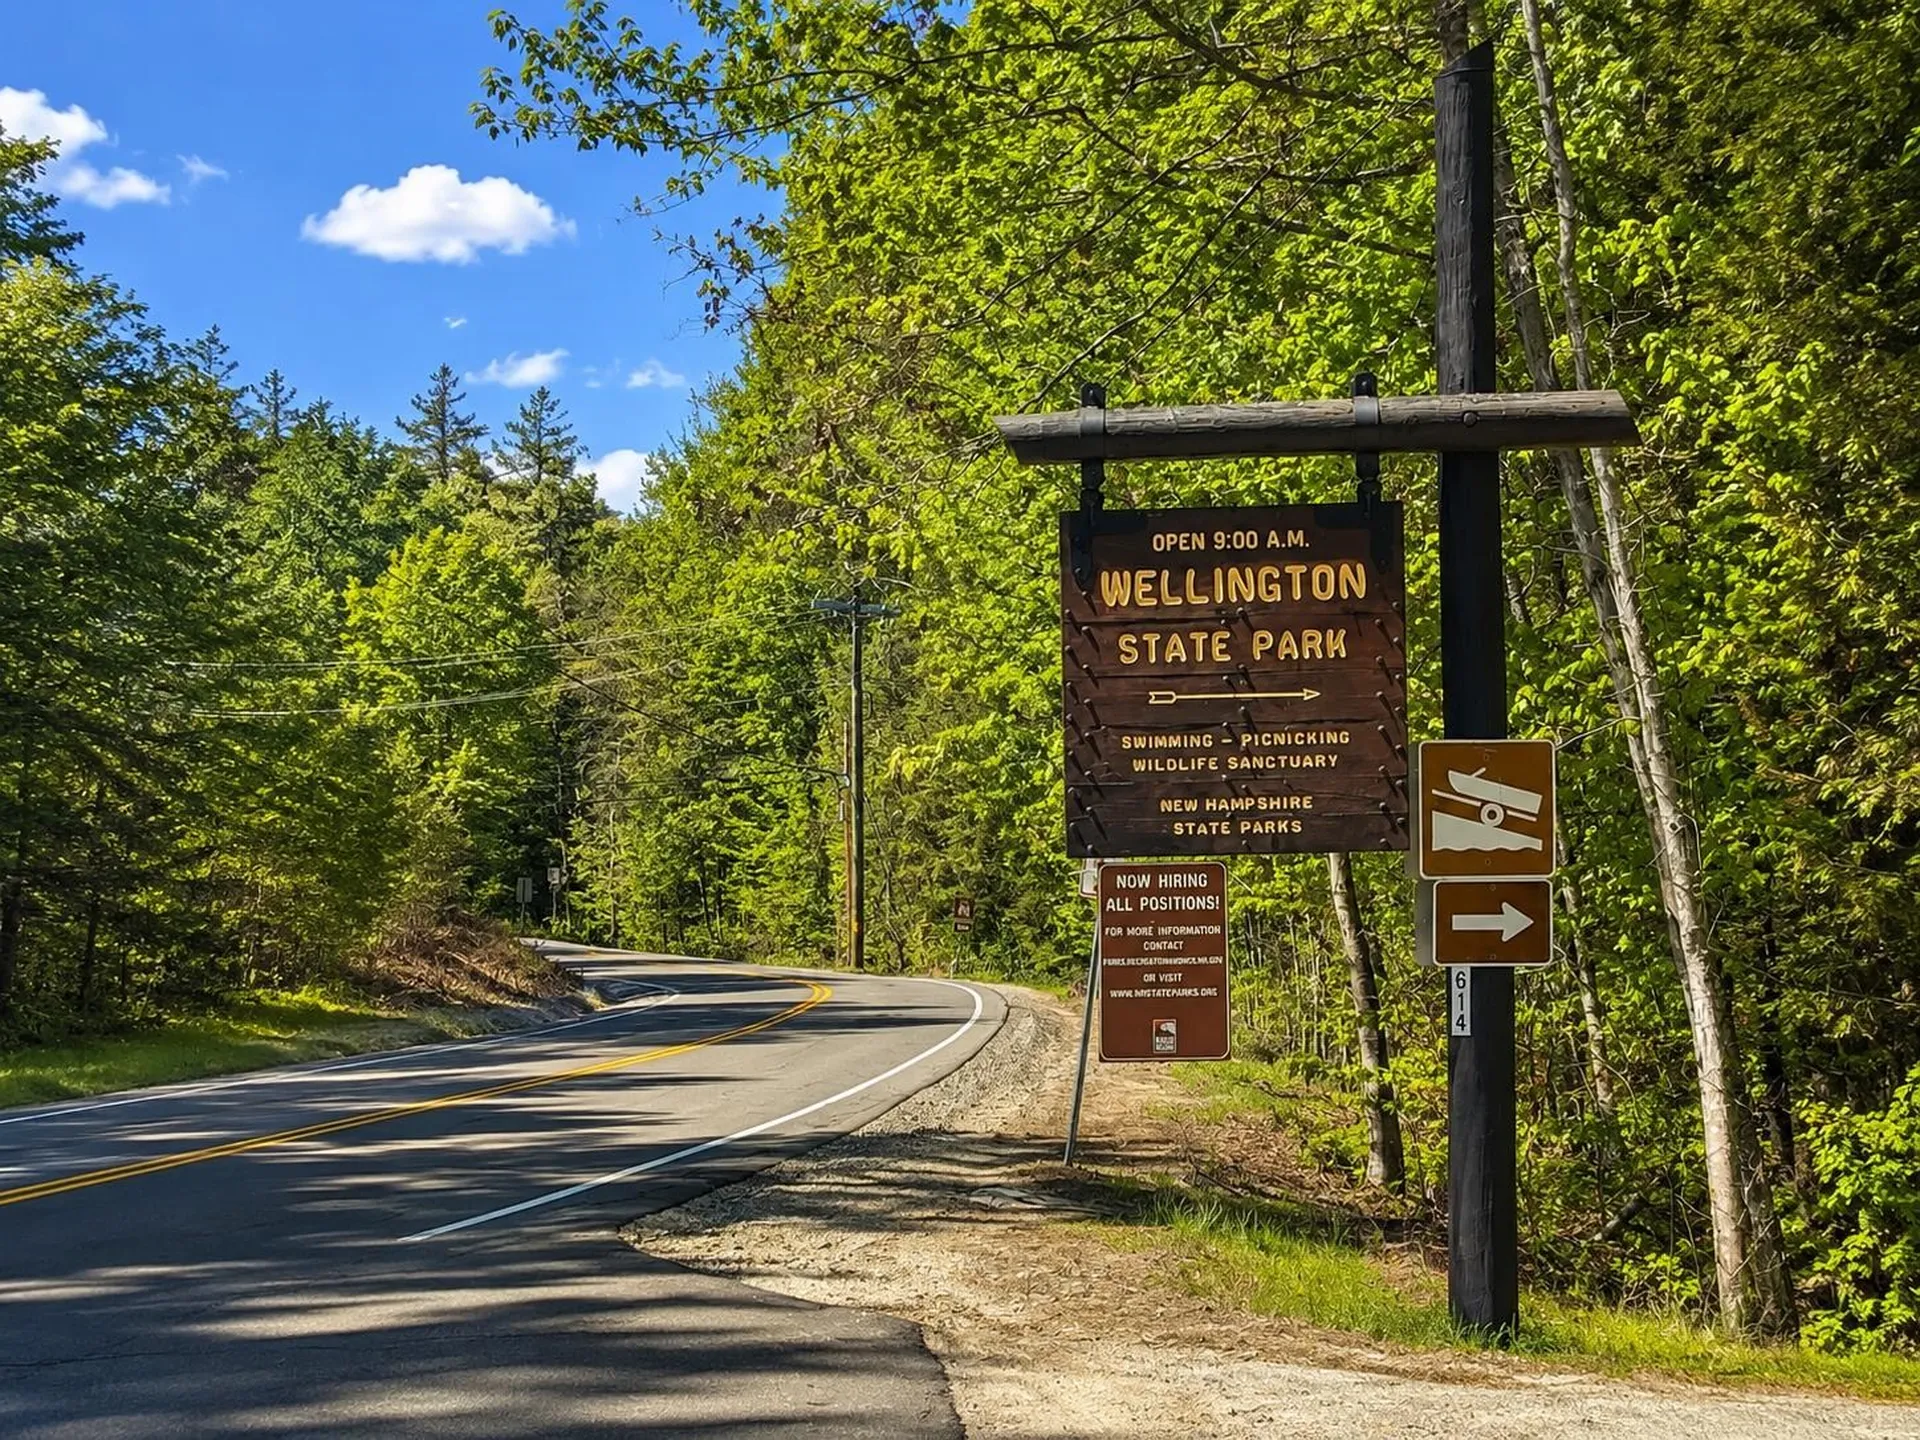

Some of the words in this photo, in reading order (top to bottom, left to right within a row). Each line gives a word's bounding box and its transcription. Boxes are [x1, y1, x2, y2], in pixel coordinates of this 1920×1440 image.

[1152, 532, 1205, 552] OPEN
[1214, 531, 1258, 549] 9:00
[1266, 530, 1310, 549] A.M.
[1100, 562, 1367, 607] WELLINGTON
[1117, 630, 1232, 664] STATE
[1252, 628, 1348, 661] PARK
[1121, 734, 1214, 750] SWIMMING
[1241, 731, 1350, 747] PICNICKING
[1132, 757, 1219, 772] WILDLIFE
[1227, 754, 1338, 770] SANCTUARY
[1160, 798, 1198, 813] NEW
[1205, 796, 1314, 812] HAMPSHIRE
[1173, 821, 1231, 836] STATE
[1240, 820, 1302, 834] PARKS
[1116, 874, 1151, 888] NOW
[1158, 873, 1208, 888] HIRING
[1105, 898, 1133, 912] ALL
[1140, 896, 1220, 911] POSITIONS!
[1104, 926, 1123, 937] FOR
[1126, 926, 1154, 936] MORE
[1158, 925, 1221, 936] INFORMATION
[1143, 941, 1184, 951] CONTACT
[1143, 973, 1156, 983] OR
[1158, 972, 1183, 983] VISIT
[1455, 970, 1467, 1031] 614
